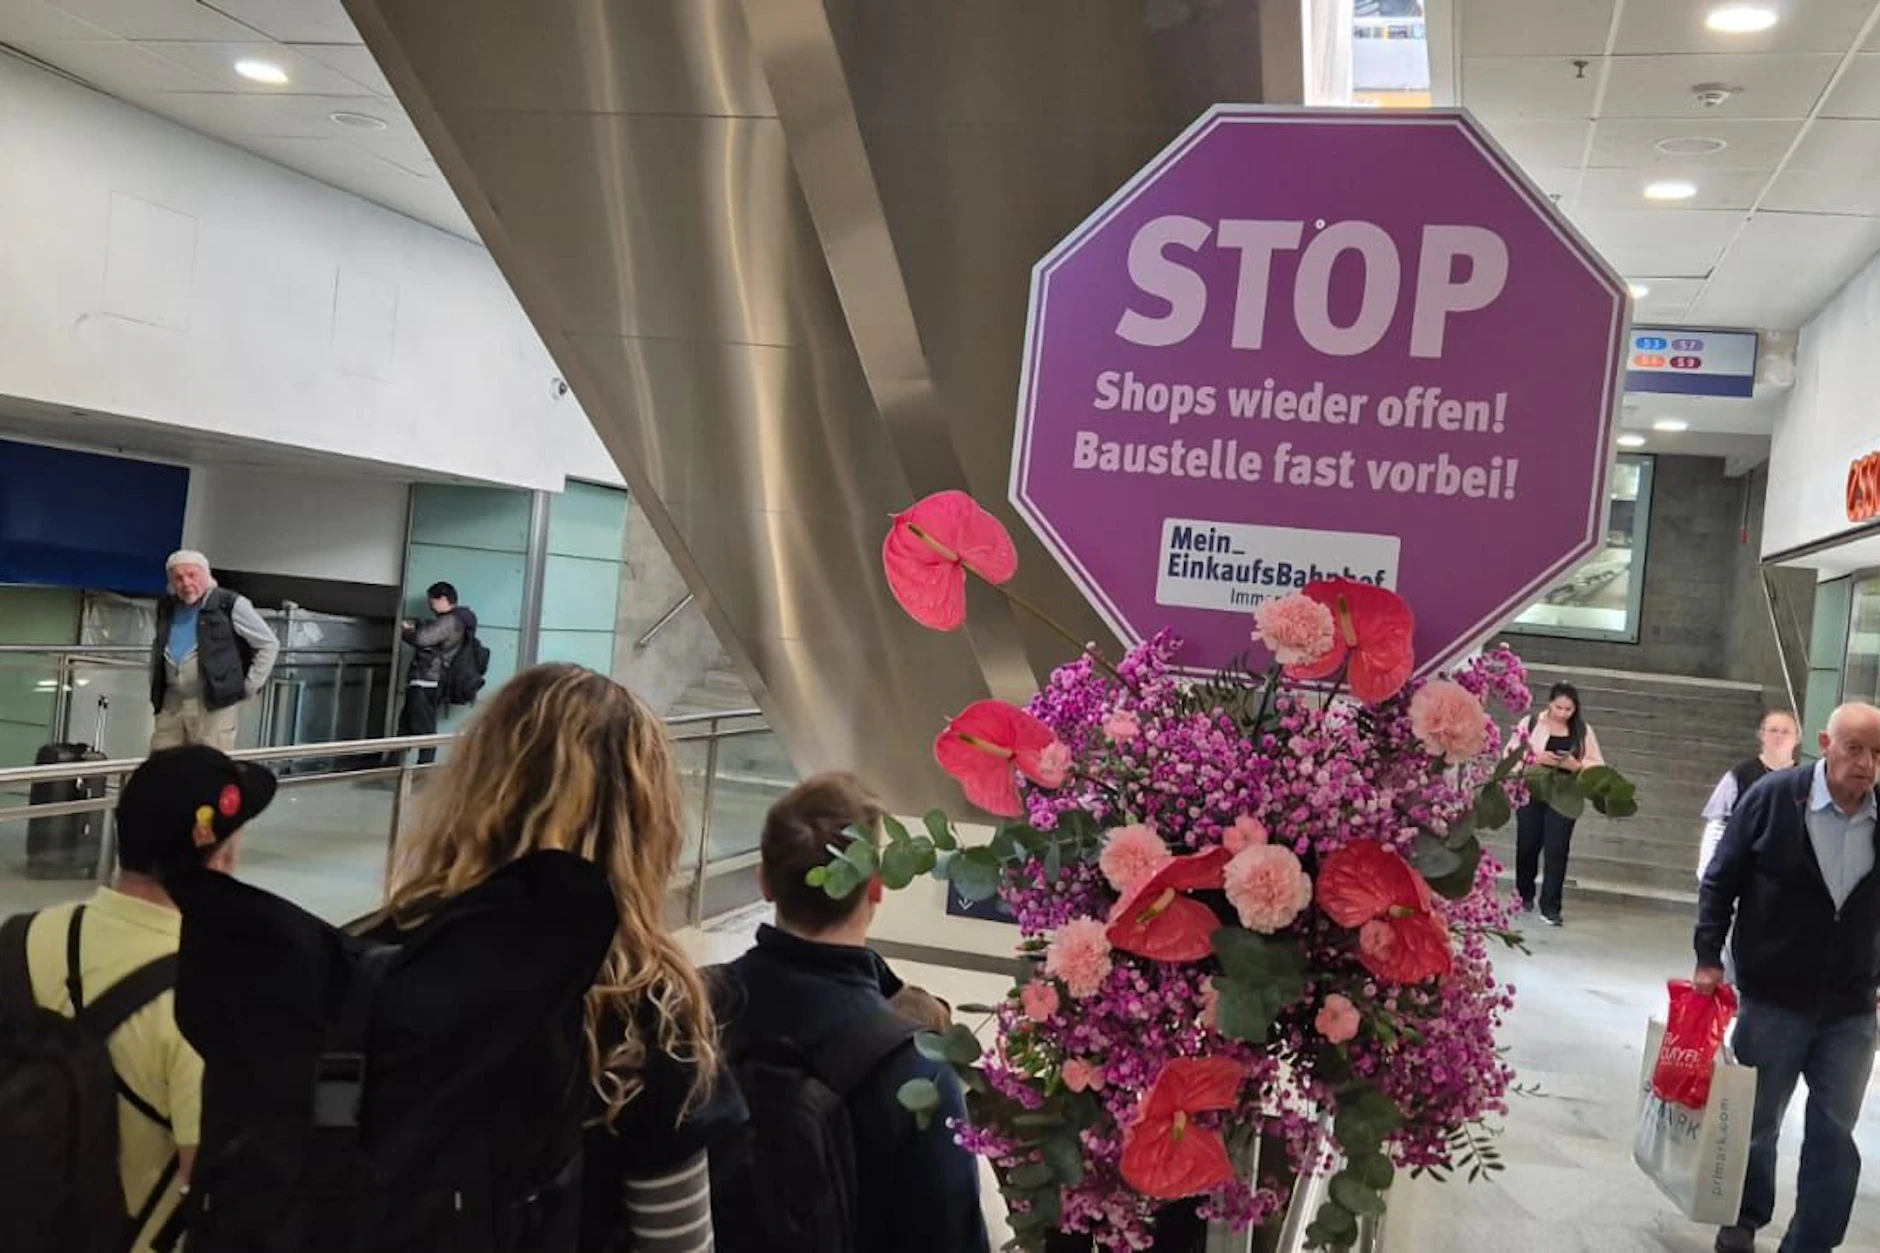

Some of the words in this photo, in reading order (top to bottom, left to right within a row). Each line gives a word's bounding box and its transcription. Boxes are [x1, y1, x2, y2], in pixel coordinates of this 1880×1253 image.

[1114, 215, 1510, 358] STOP
[1093, 371, 1217, 425] Shops
[1228, 379, 1368, 425] wieder
[1377, 386, 1508, 433] offen!
[1073, 432, 1262, 482] Baustelle
[1273, 442, 1355, 490] fast
[1367, 455, 1518, 500] vorbei!
[1711, 1097, 1731, 1196] primark.com
